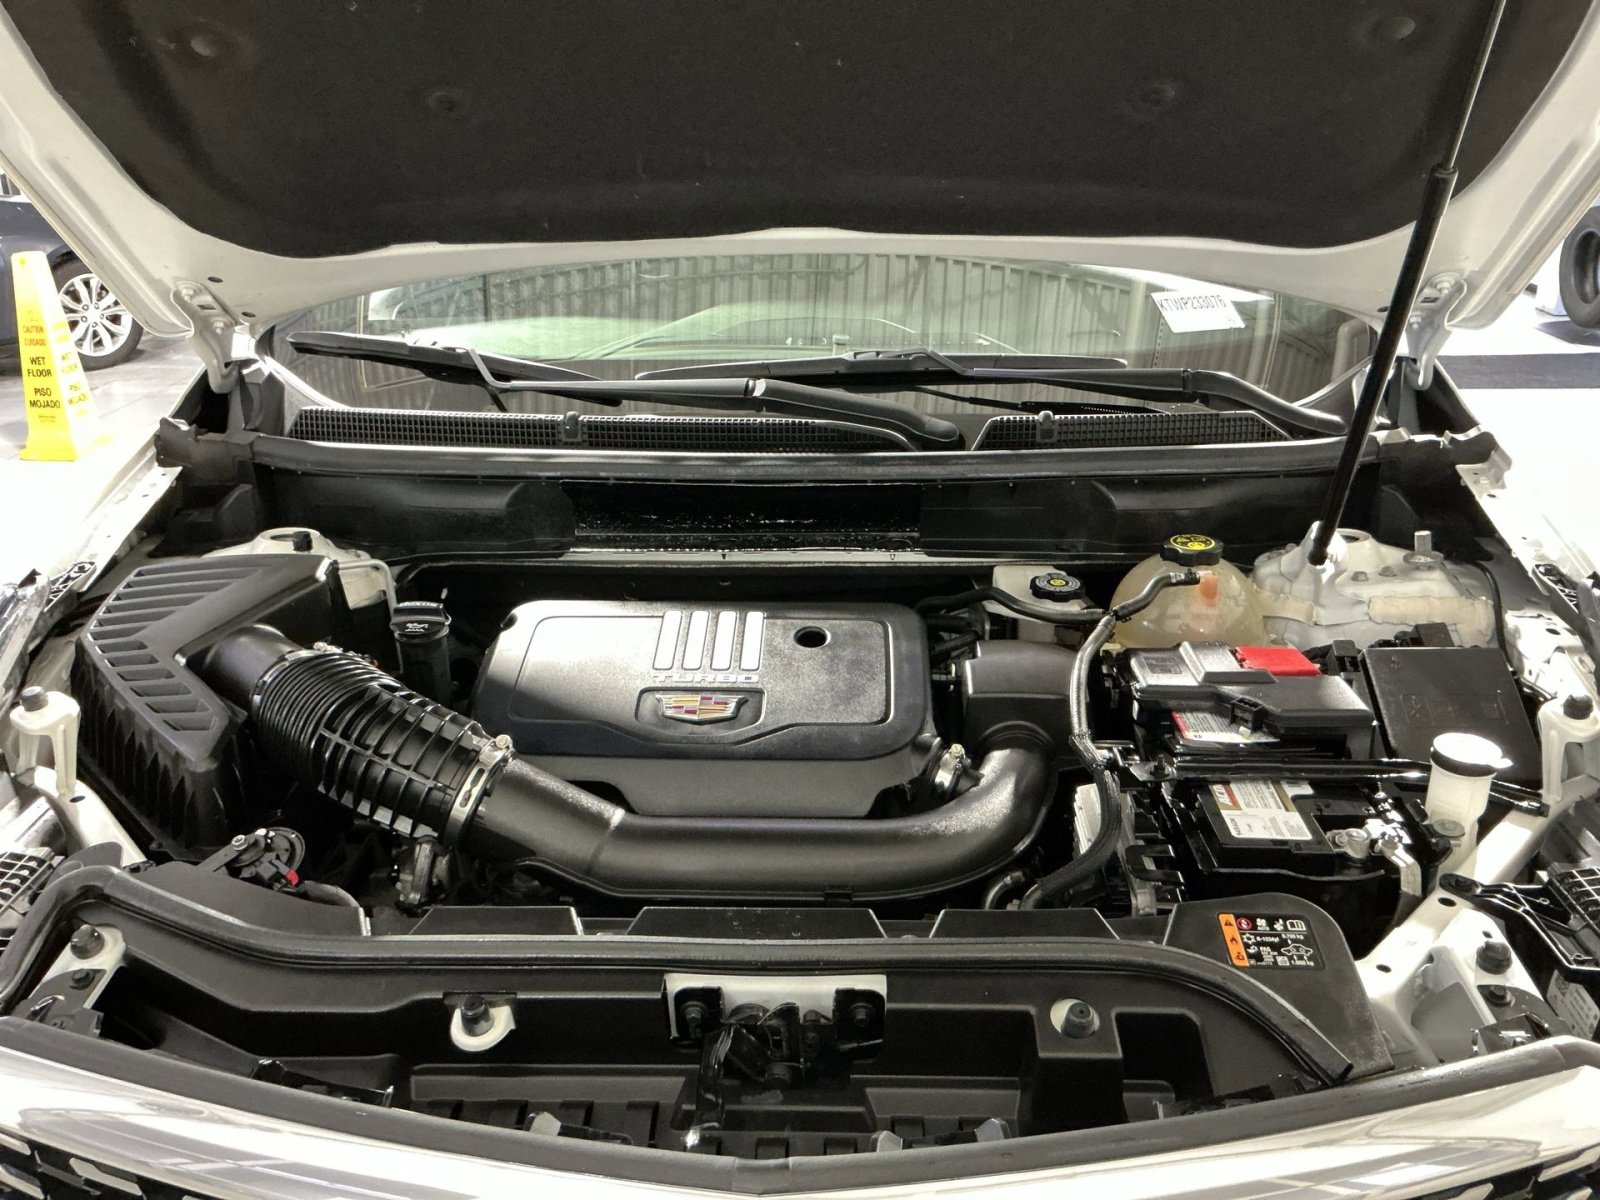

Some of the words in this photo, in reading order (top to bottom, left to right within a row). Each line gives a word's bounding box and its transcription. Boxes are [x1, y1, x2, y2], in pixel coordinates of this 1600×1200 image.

[29, 356, 45, 366] WET
[27, 368, 53, 378] FLOOR
[33, 387, 52, 397] PISO
[29, 399, 61, 409] MOJADO
